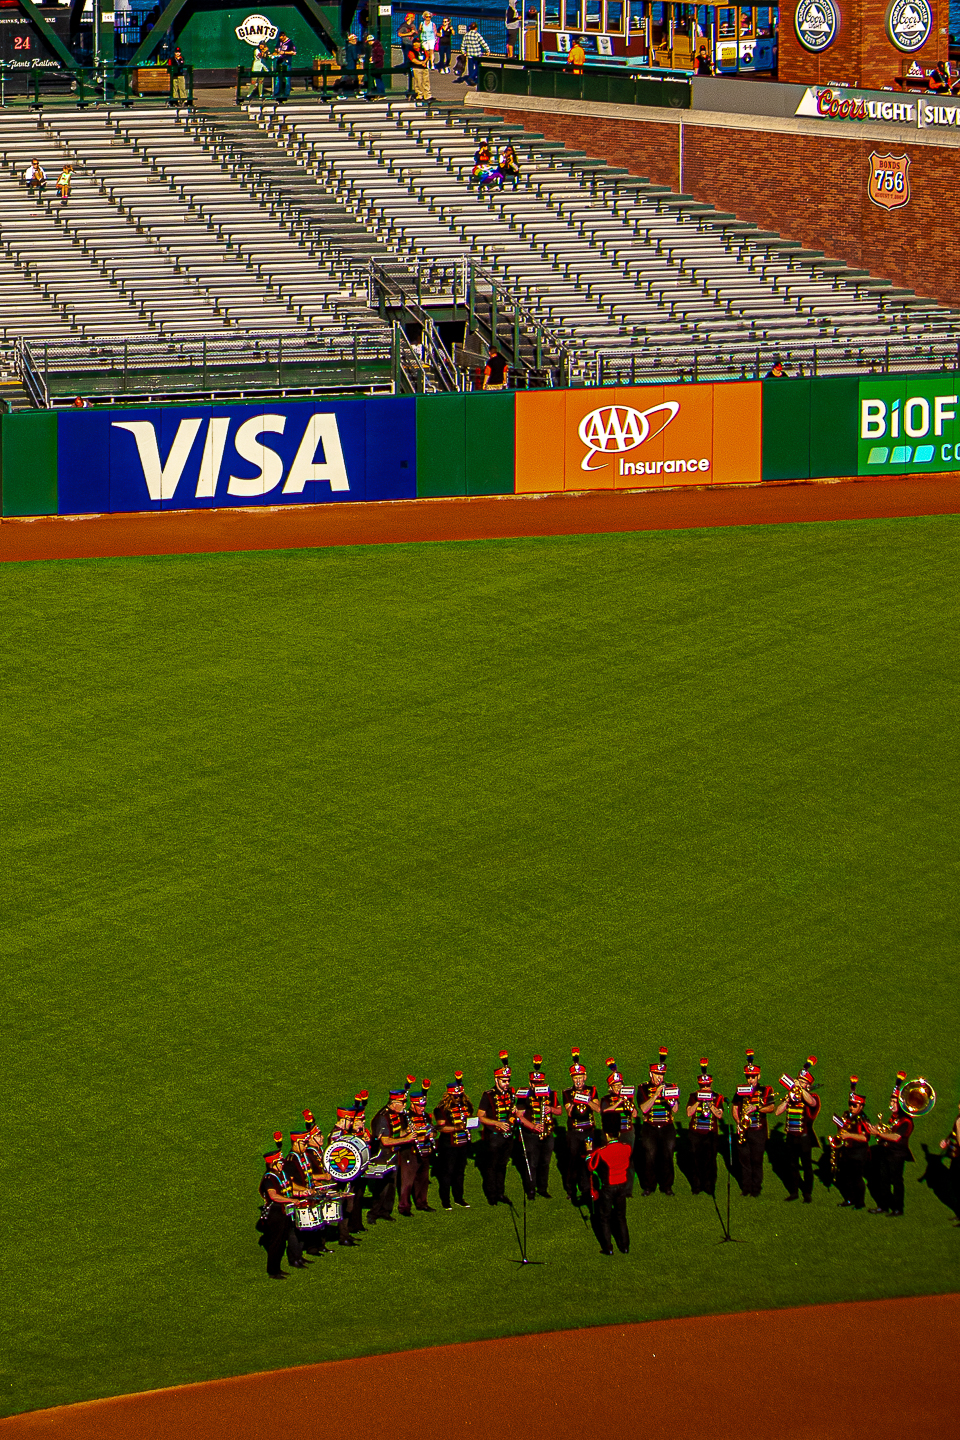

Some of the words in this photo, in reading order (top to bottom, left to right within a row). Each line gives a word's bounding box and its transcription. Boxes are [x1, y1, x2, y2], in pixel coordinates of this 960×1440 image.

[238, 25, 276, 38] GIANTS
[14, 37, 31, 49] 24
[817, 88, 868, 120] Coors
[868, 100, 913, 122] LIGHT
[879, 160, 901, 169] BONDS
[874, 169, 904, 193] 756
[586, 407, 641, 450] AAA
[111, 412, 350, 501] VISA
[619, 458, 710, 476] Insurance
